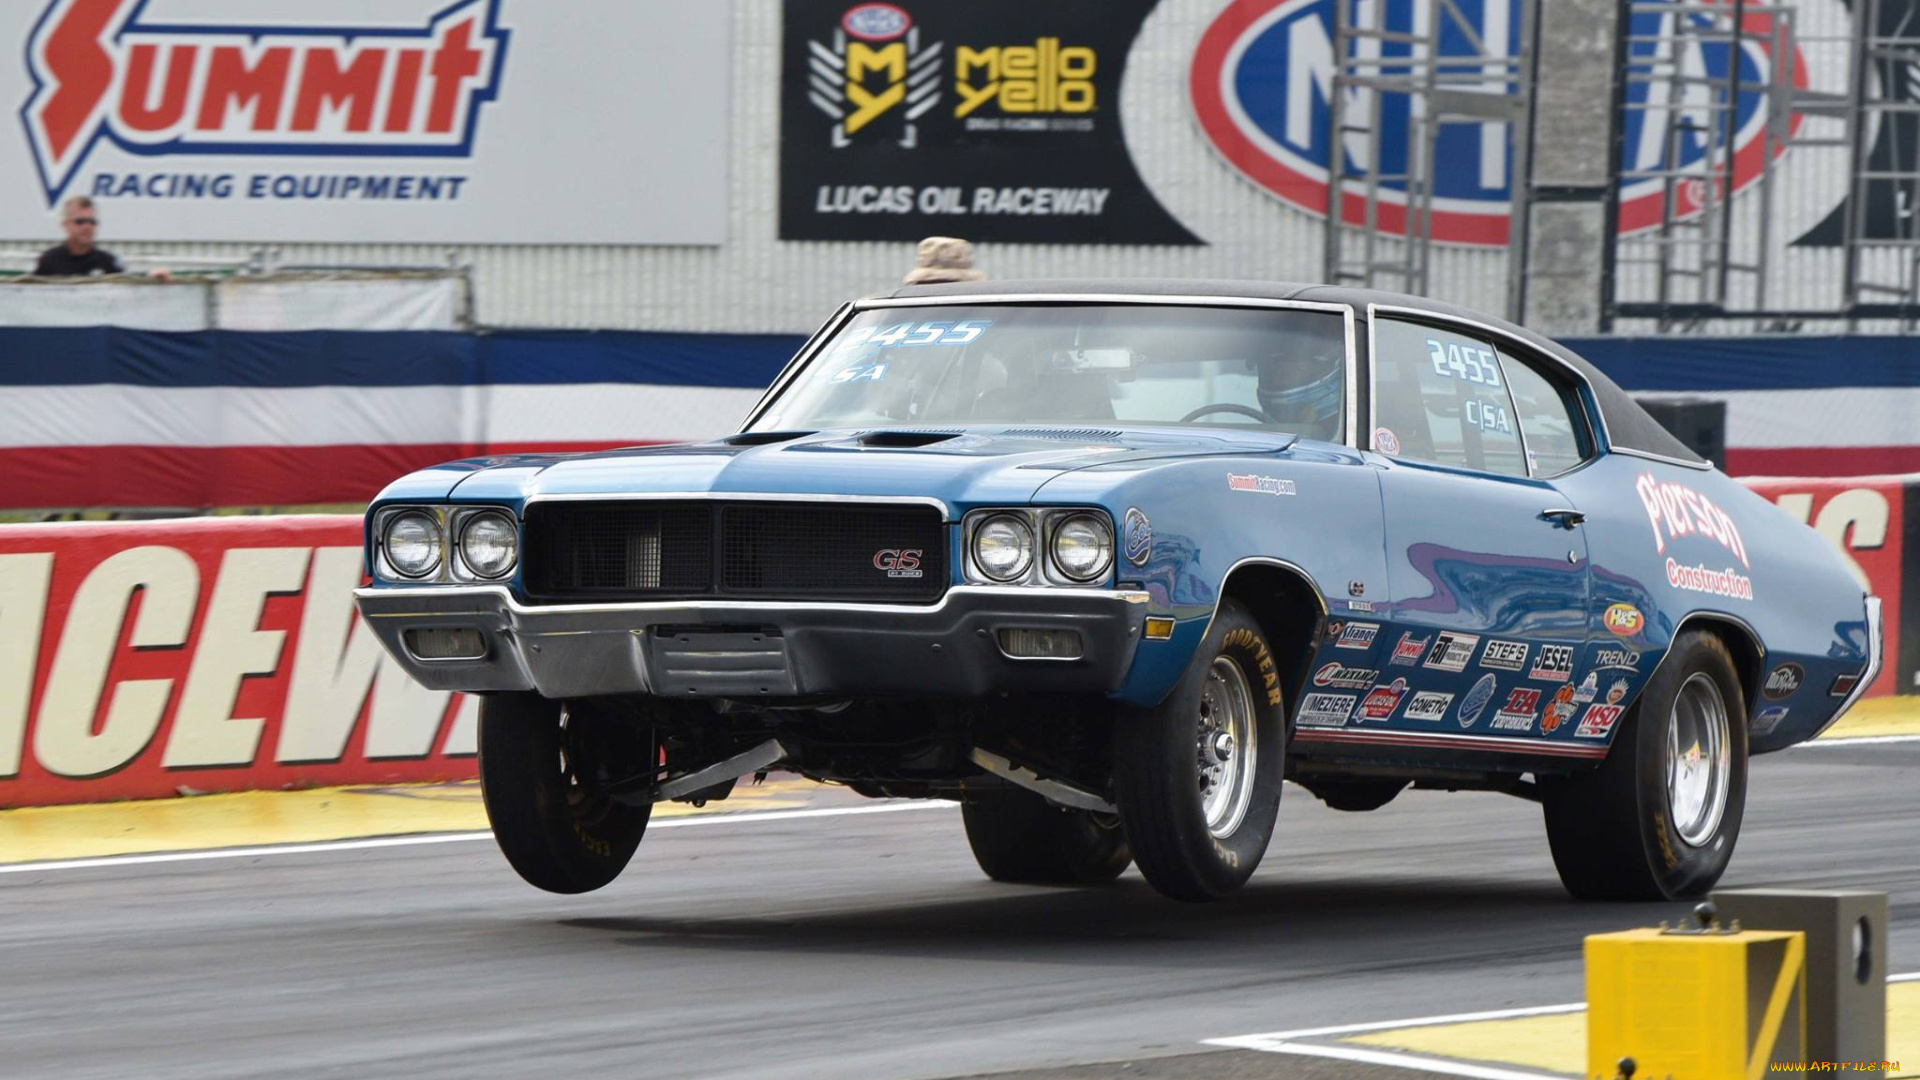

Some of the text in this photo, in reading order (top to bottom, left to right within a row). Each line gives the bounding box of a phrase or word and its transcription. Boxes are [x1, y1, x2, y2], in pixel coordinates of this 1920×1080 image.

[93, 173, 468, 200] RACING EQUIPMENT
[816, 186, 1110, 215] LUCAS OIL RACEWAY
[1427, 340, 1501, 387] 2455
[873, 548, 923, 571] GS
[1665, 557, 1753, 601] Construction
[1609, 609, 1637, 628] H&S
[1486, 641, 1526, 660] STEF'S
[1534, 646, 1574, 672] JESEL
[1595, 650, 1640, 666] TREND
[1221, 628, 1281, 706] GOODYEAR
[1309, 695, 1355, 713] MEZIERE
[1409, 697, 1449, 714] COMETIC
[1582, 705, 1621, 727] MSD
